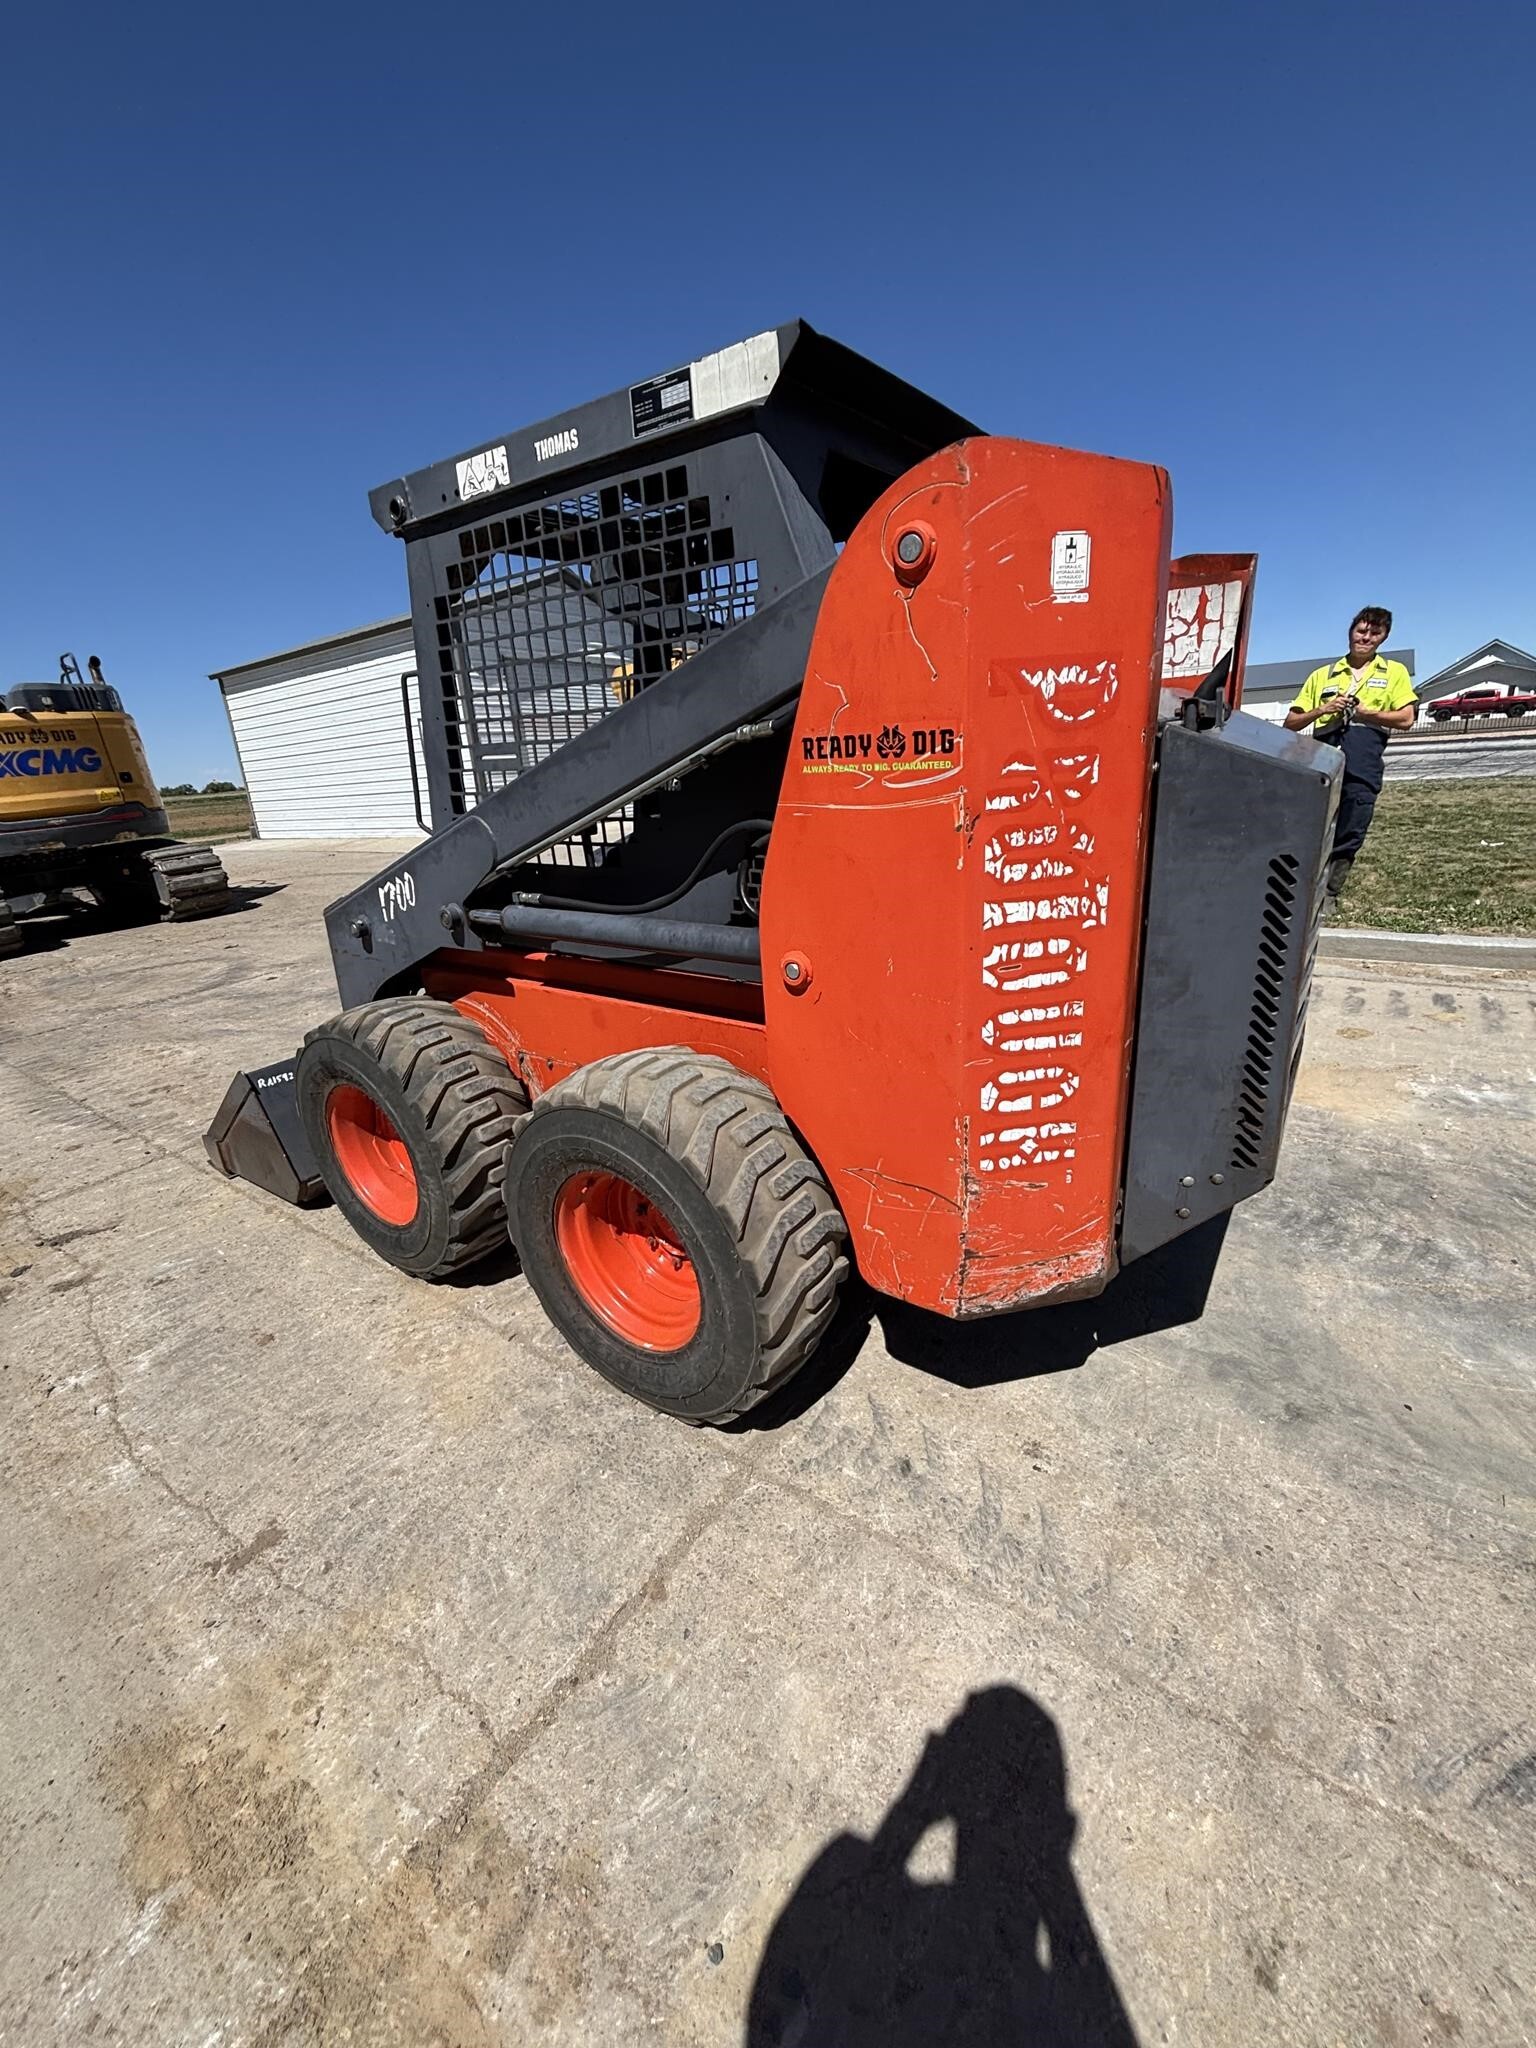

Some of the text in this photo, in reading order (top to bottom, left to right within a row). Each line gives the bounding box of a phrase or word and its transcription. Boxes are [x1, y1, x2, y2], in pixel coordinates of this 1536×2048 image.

[534, 428, 579, 462] THOMAS
[50, 729, 77, 743] DIG
[802, 728, 955, 760] READY DIG
[802, 765, 833, 774] ALWAYS
[833, 764, 859, 773] READY
[861, 763, 873, 772] TO
[892, 760, 955, 771] GUARANTEED.
[378, 871, 416, 922] 1700
